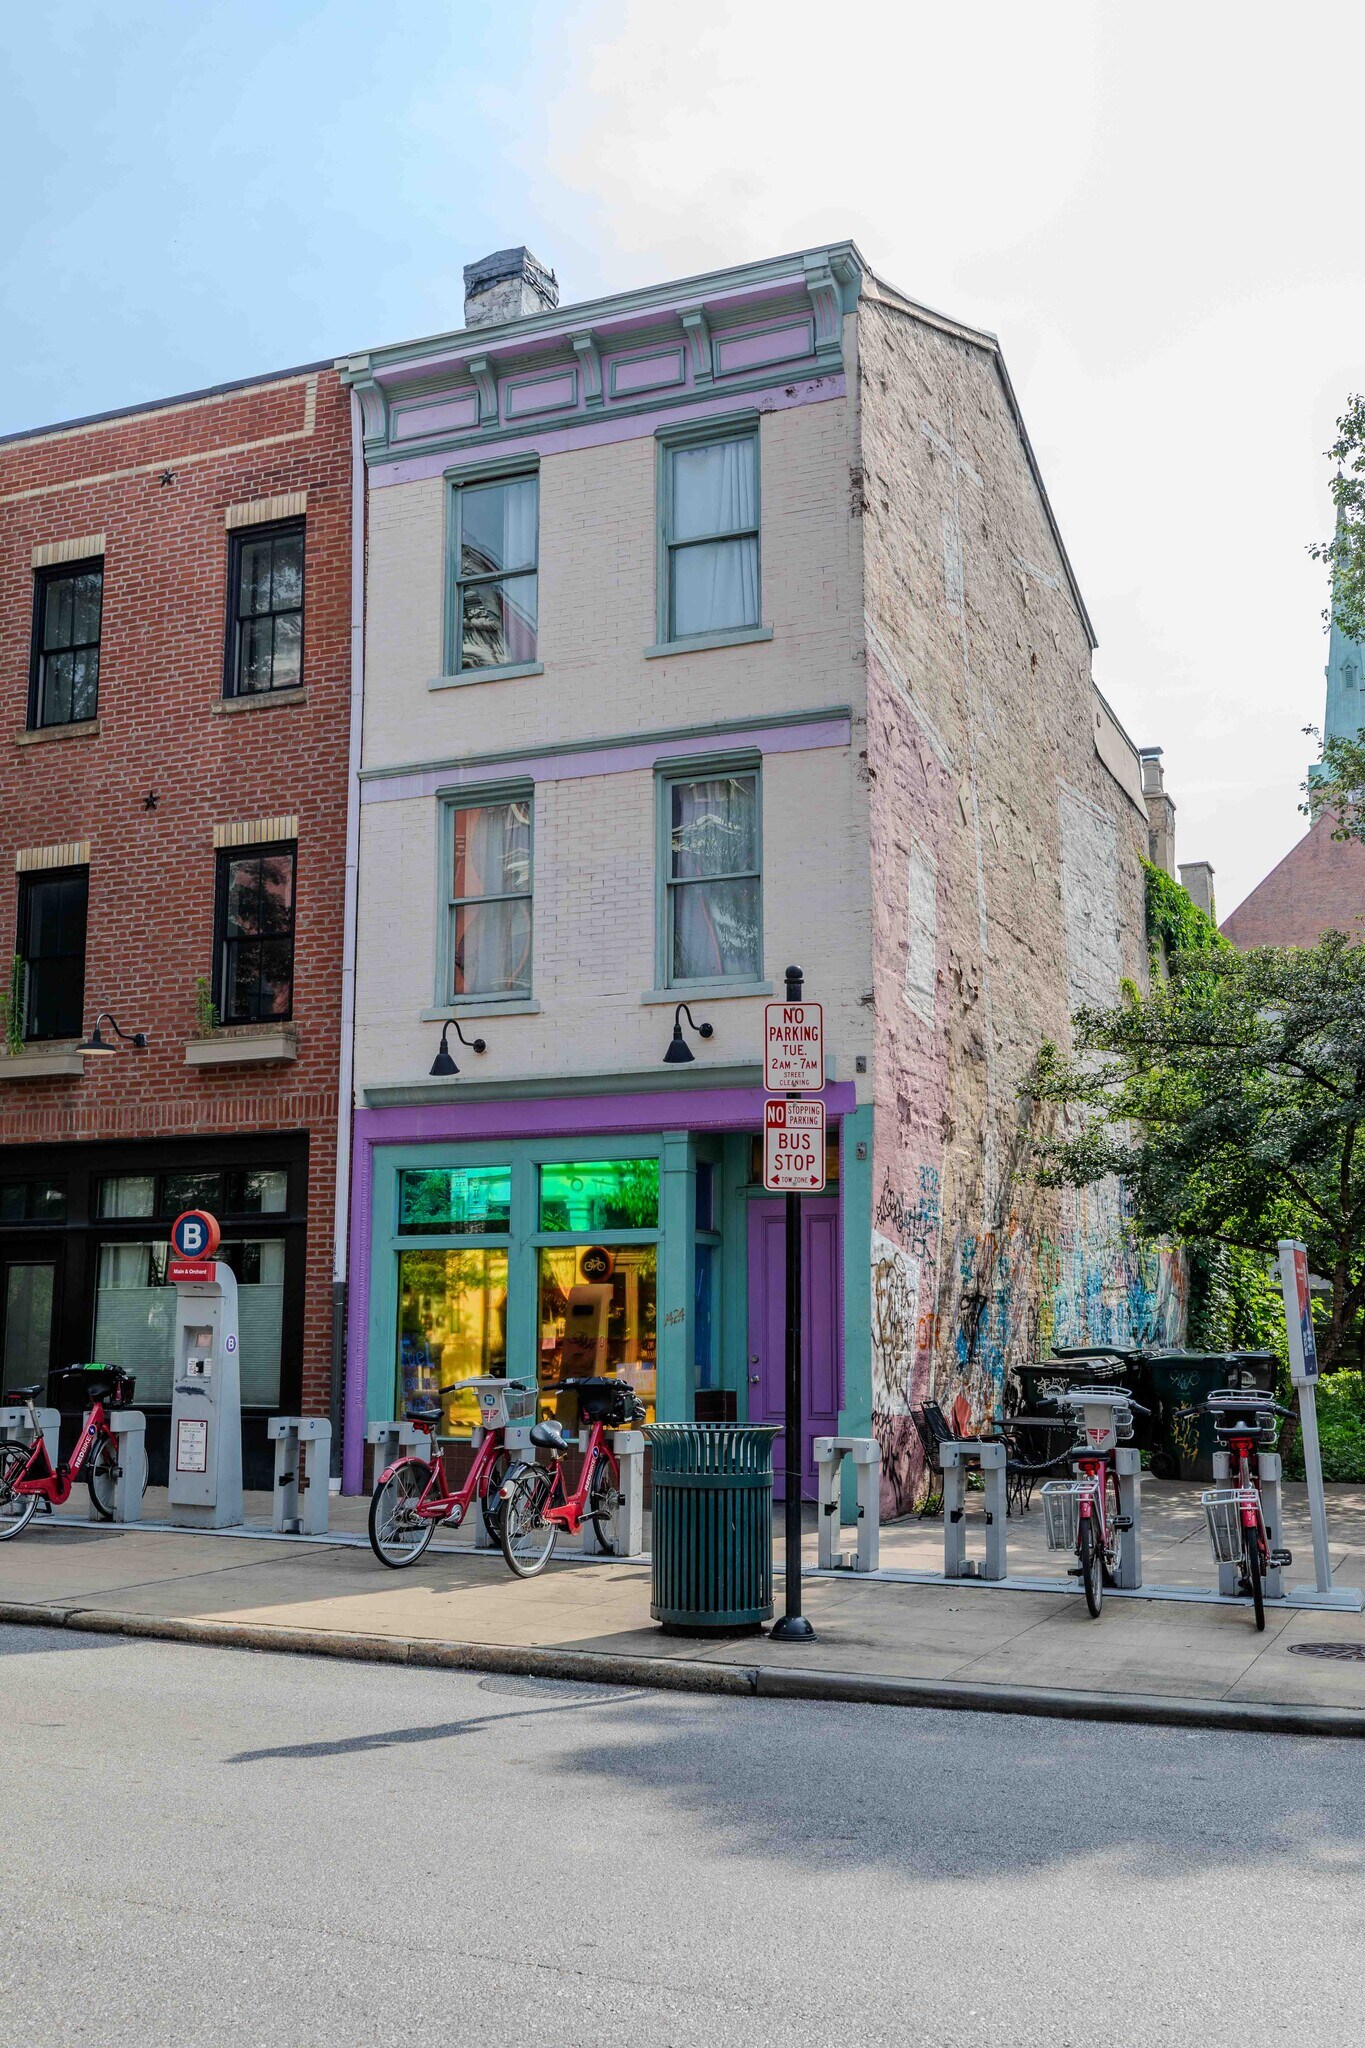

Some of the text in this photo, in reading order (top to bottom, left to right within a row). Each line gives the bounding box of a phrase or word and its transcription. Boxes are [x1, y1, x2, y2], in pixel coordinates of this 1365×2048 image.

[783, 1007, 804, 1024] NO
[769, 1026, 819, 1042] PARKING
[782, 1044, 807, 1056] TUE.
[771, 1058, 791, 1069] 2AM
[800, 1058, 817, 1069] 7AM
[767, 1105, 785, 1123] NO
[787, 1105, 820, 1115] STOPPING
[789, 1115, 818, 1125] PARKING
[778, 1133, 811, 1150] BUS
[774, 1154, 816, 1171] STOP
[781, 1175, 793, 1183] TOW
[183, 1223, 202, 1250] B
[228, 1336, 235, 1350] B
[75, 1436, 92, 1469] REDBIKE
[585, 1458, 598, 1491] REDBIKE
